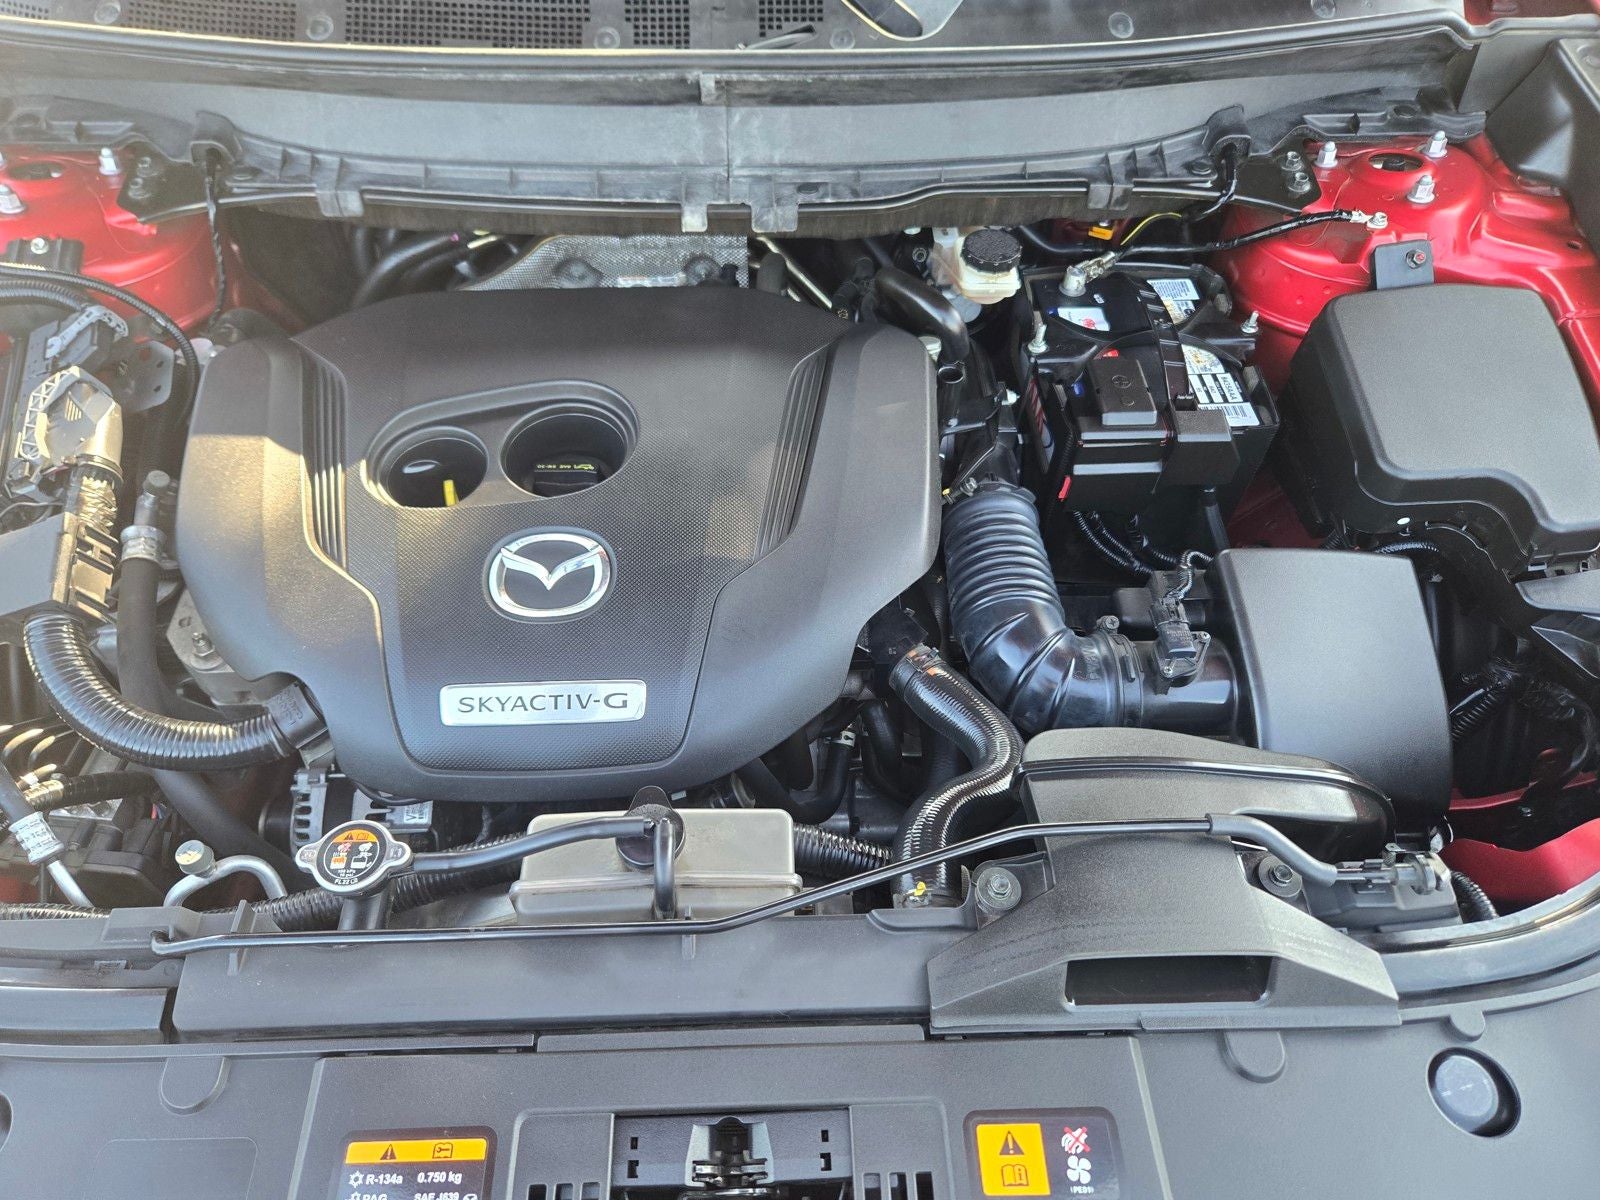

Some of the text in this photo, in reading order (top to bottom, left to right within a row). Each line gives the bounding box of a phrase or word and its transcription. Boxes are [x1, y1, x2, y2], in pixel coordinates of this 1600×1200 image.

[457, 692, 628, 713] SKYACTIV-G
[365, 1173, 403, 1185] R-134a
[416, 1170, 463, 1185] 0.750 kg
